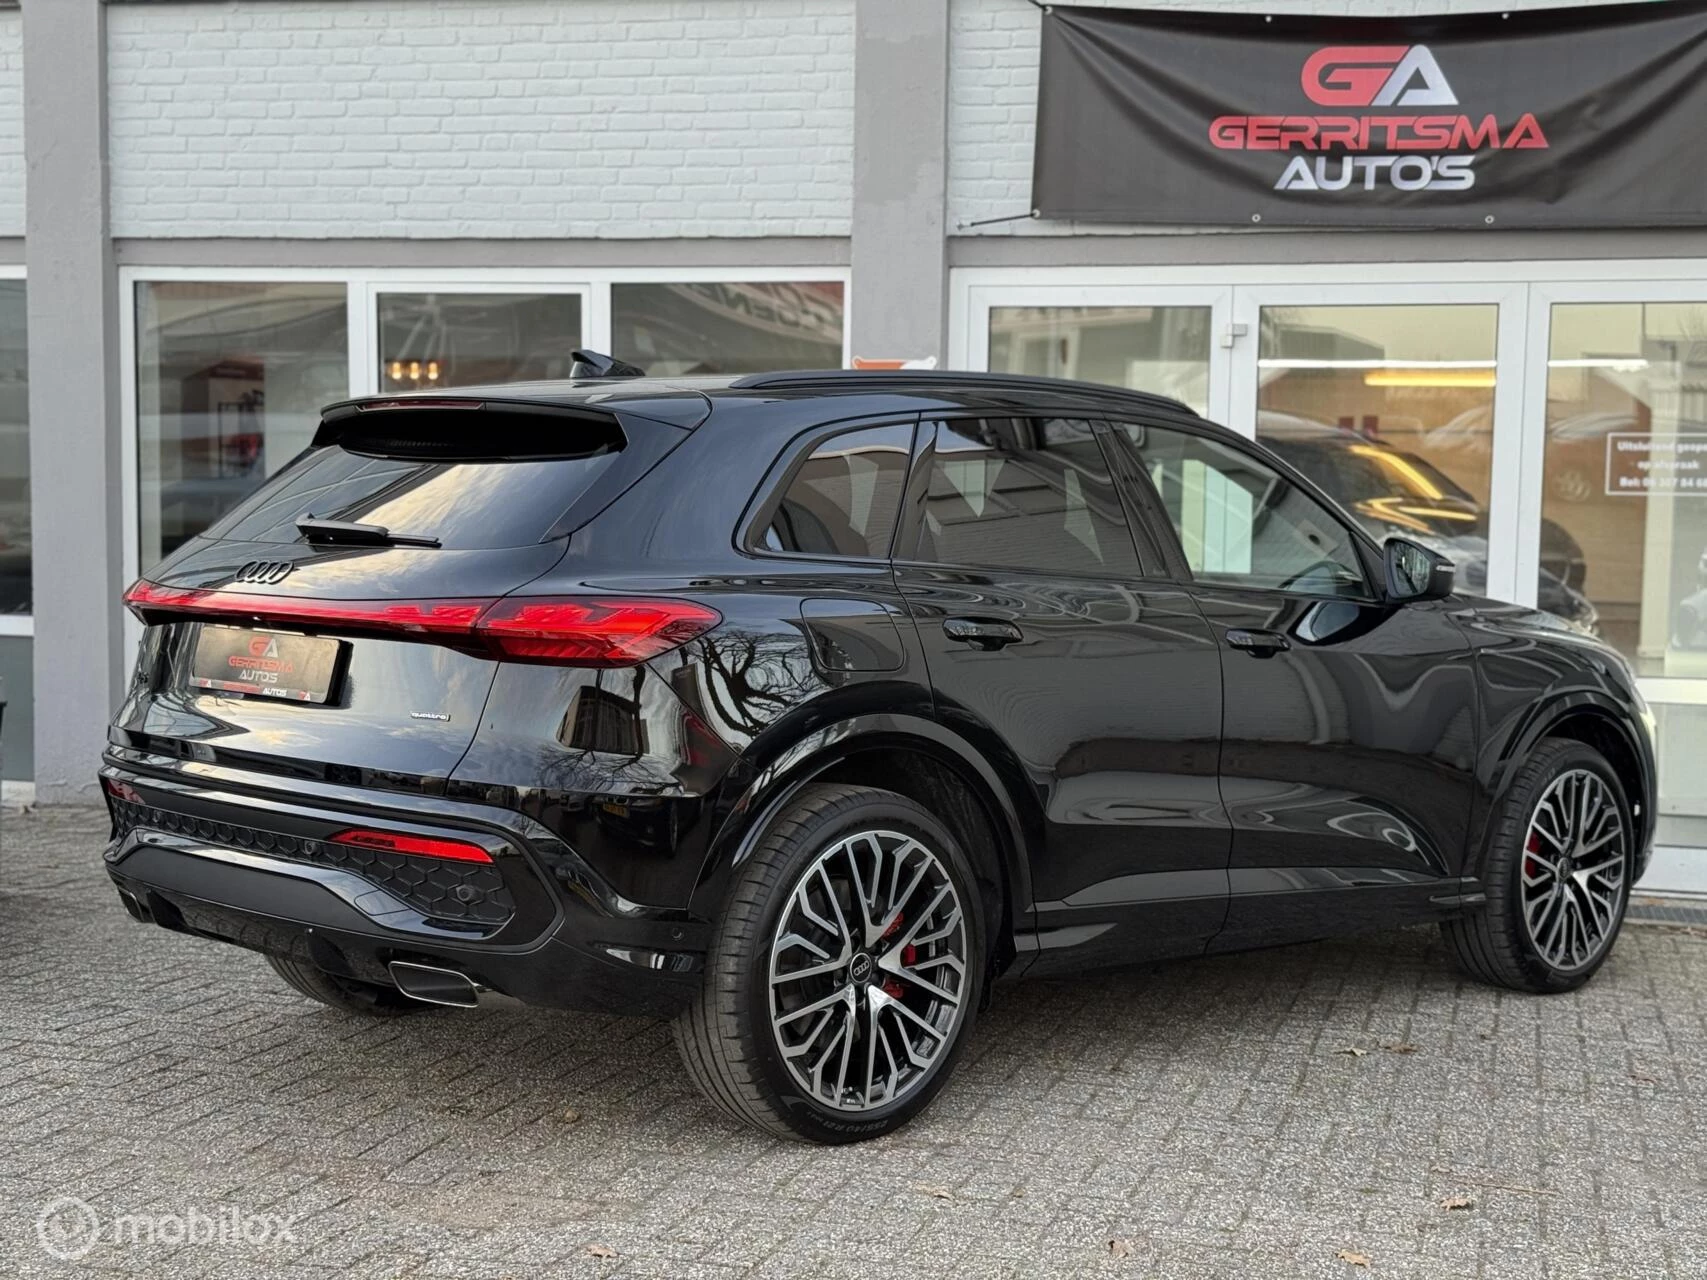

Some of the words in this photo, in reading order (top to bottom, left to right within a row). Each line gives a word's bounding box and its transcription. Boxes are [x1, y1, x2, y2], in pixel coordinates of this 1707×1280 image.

[1301, 44, 1459, 107] GA
[1209, 112, 1549, 150] GERRITSMA
[1273, 155, 1476, 191] AUTO'S
[248, 635, 279, 658] GA
